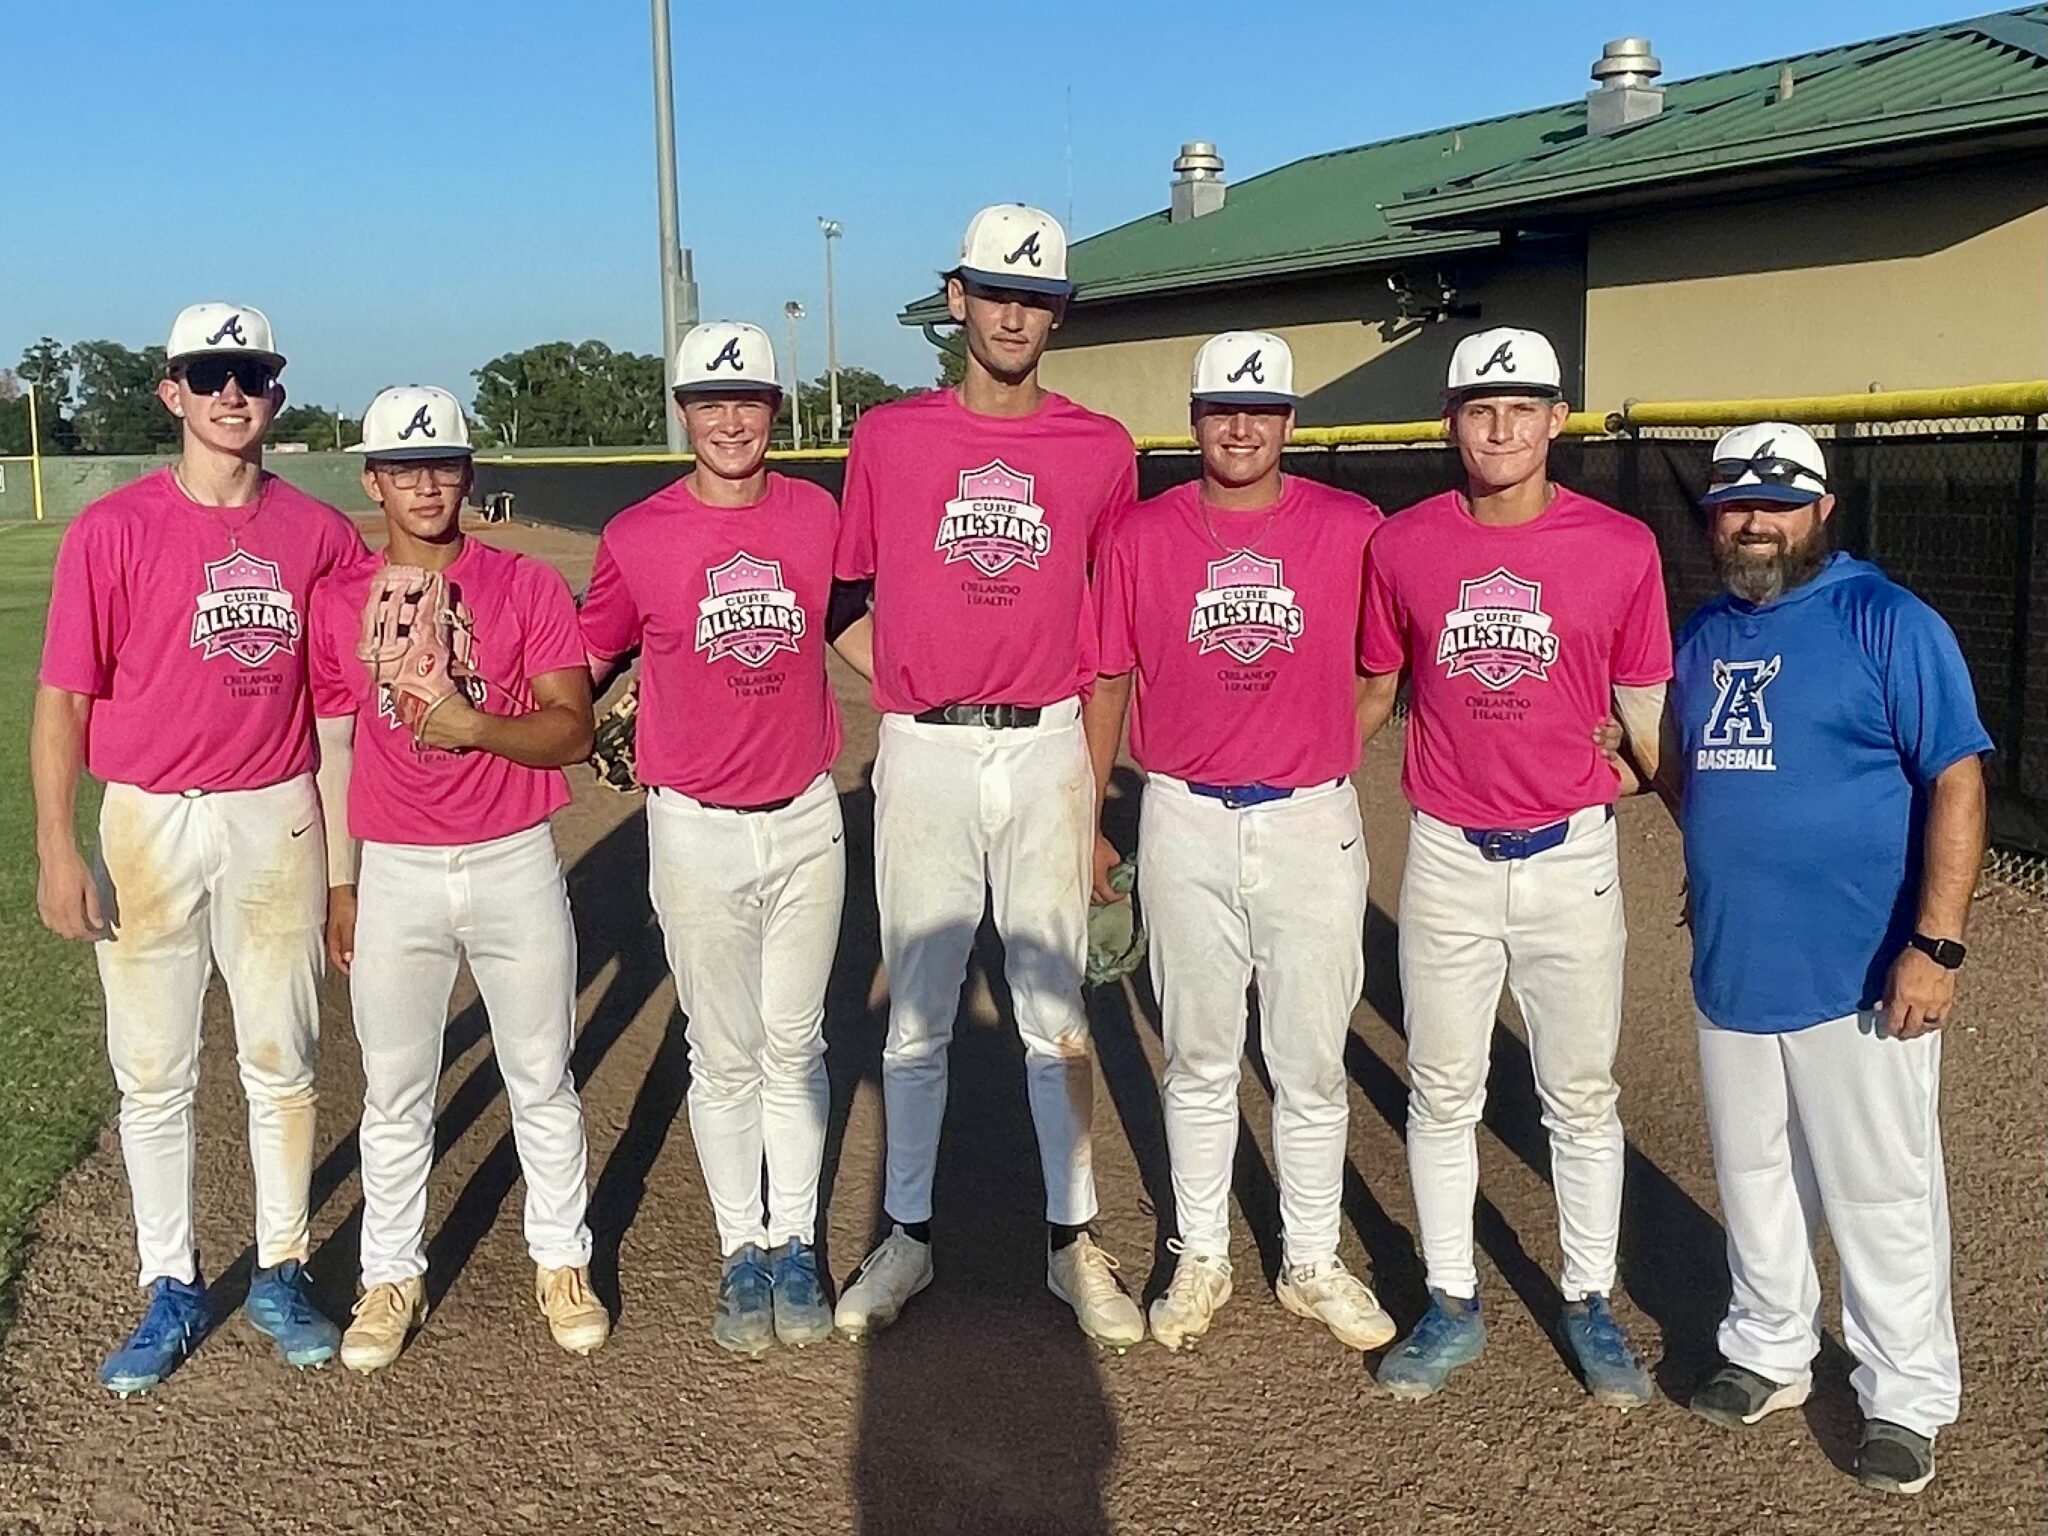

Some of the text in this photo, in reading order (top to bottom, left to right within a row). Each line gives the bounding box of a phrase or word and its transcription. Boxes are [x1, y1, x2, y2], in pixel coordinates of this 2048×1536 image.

[1004, 230, 1042, 268] A
[206, 314, 247, 346] A
[706, 337, 744, 371] A
[1476, 340, 1516, 376] A
[1227, 349, 1264, 384] A
[398, 404, 436, 440] A
[973, 502, 1017, 514] CURE
[961, 581, 1021, 595] ORLANDO
[1222, 590, 1269, 600] CURE
[224, 592, 269, 603] CURE
[725, 593, 770, 607] CURE
[1474, 612, 1524, 624] CURE
[727, 673, 787, 687] ORLANDO
[1465, 696, 1531, 709] ORLANDO
[1697, 748, 1777, 771] BASEBALL
